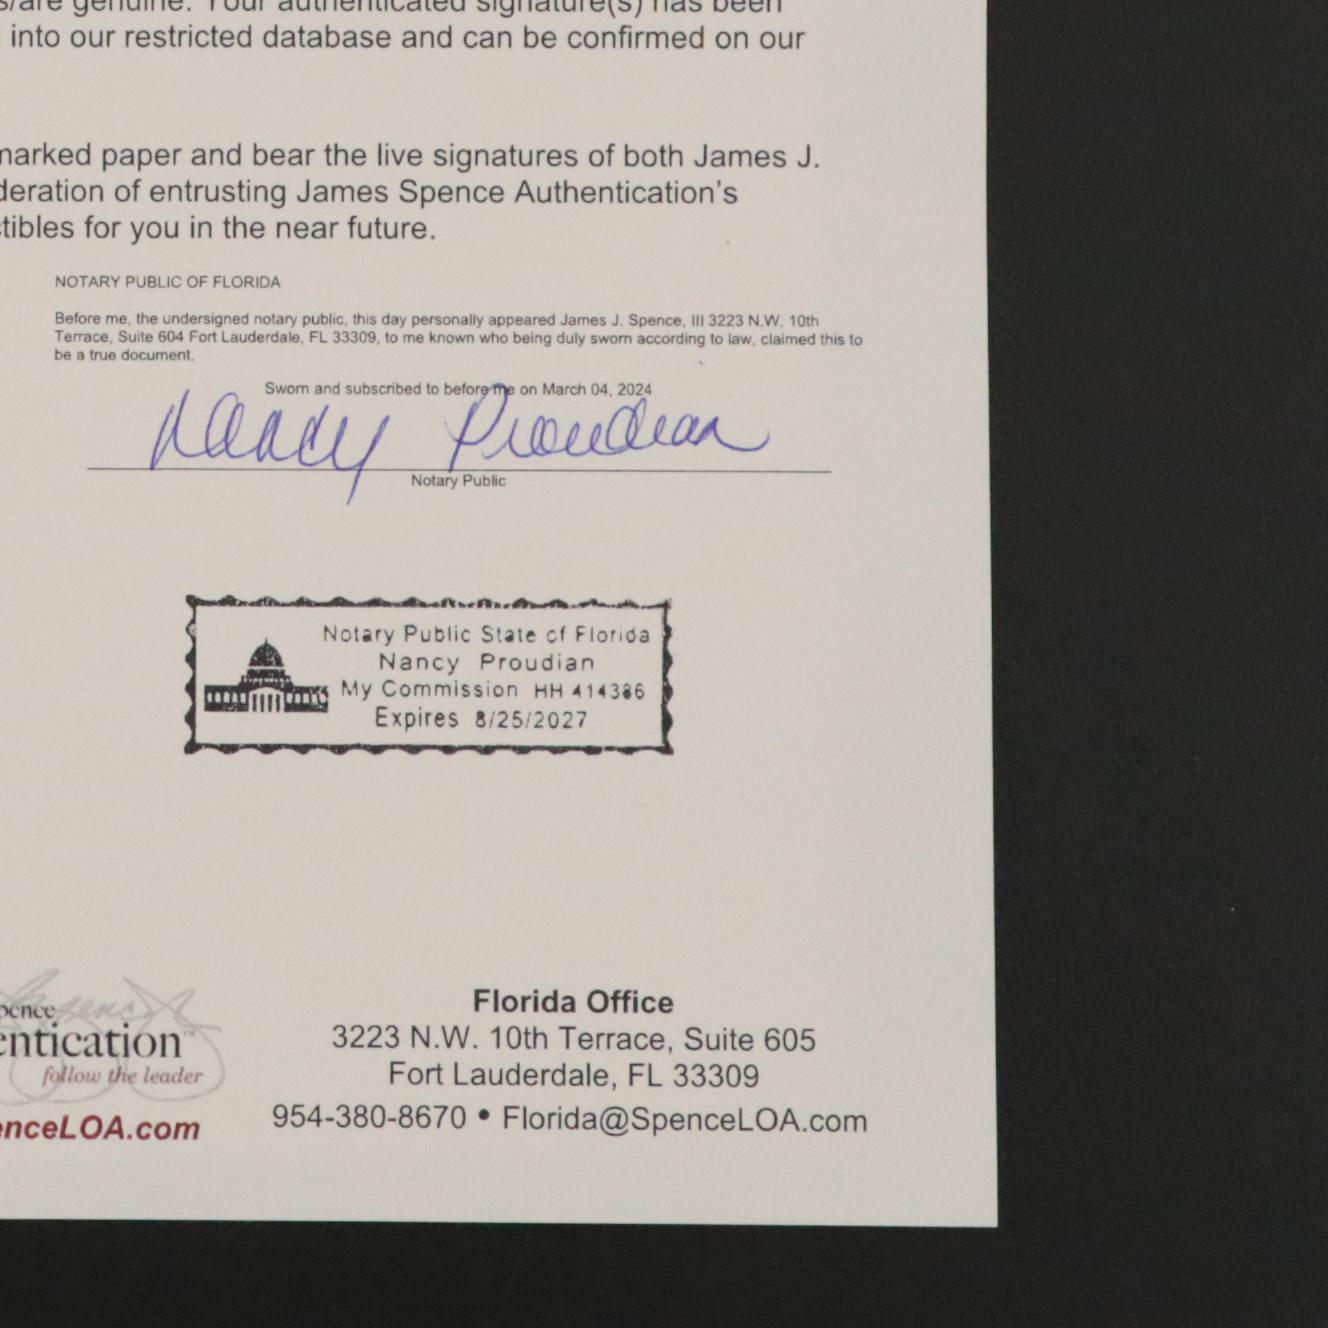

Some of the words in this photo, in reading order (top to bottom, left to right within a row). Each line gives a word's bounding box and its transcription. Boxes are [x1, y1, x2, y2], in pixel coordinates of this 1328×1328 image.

[56, 275, 120, 288] NOTARY
[126, 275, 182, 288] PUBLIC
[187, 275, 208, 288] OF
[213, 275, 280, 288] FLORIDA
[54, 348, 71, 360] be
[76, 351, 85, 360] a
[90, 349, 116, 361] true
[121, 349, 194, 361] document.
[265, 381, 309, 395] Sworn
[314, 382, 340, 395] and
[345, 382, 421, 395] subscribed
[426, 383, 439, 395] to
[444, 381, 489, 395] before
[492, 384, 515, 395] me
[519, 384, 538, 396] on
[542, 381, 587, 396] March
[590, 382, 613, 398] 04,
[617, 382, 653, 396] 2024
[412, 474, 458, 490] Notary
[463, 474, 506, 487] Public
[324, 625, 394, 646] Notary
[404, 624, 470, 643] Public
[482, 625, 536, 643] State
[576, 625, 649, 643] Florida
[380, 653, 459, 676] Nancy
[481, 653, 594, 672] Proudian
[342, 680, 372, 701] My
[382, 679, 517, 698] Commission
[535, 683, 563, 698] HH
[375, 706, 458, 732] Expires
[475, 710, 587, 729] 8/25/2027
[474, 988, 576, 1013] Florida
[587, 989, 674, 1014] Office
[333, 1024, 400, 1049] 3223
[411, 1025, 478, 1049] N.W.
[491, 1026, 548, 1050] 10th
[558, 1026, 672, 1054] Terrace,
[685, 1026, 754, 1051] Suite
[764, 1028, 816, 1052] 605
[41, 1065, 102, 1087] follow
[107, 1066, 138, 1085] the
[143, 1066, 204, 1085] leader
[390, 1061, 443, 1085] Fort
[454, 1062, 616, 1091] Lauderdale,
[629, 1063, 663, 1087] FL
[674, 1063, 759, 1088] 33309
[273, 1104, 466, 1129] 954-380-8670
[504, 1105, 867, 1137] Florida@SpenceLOA.com
